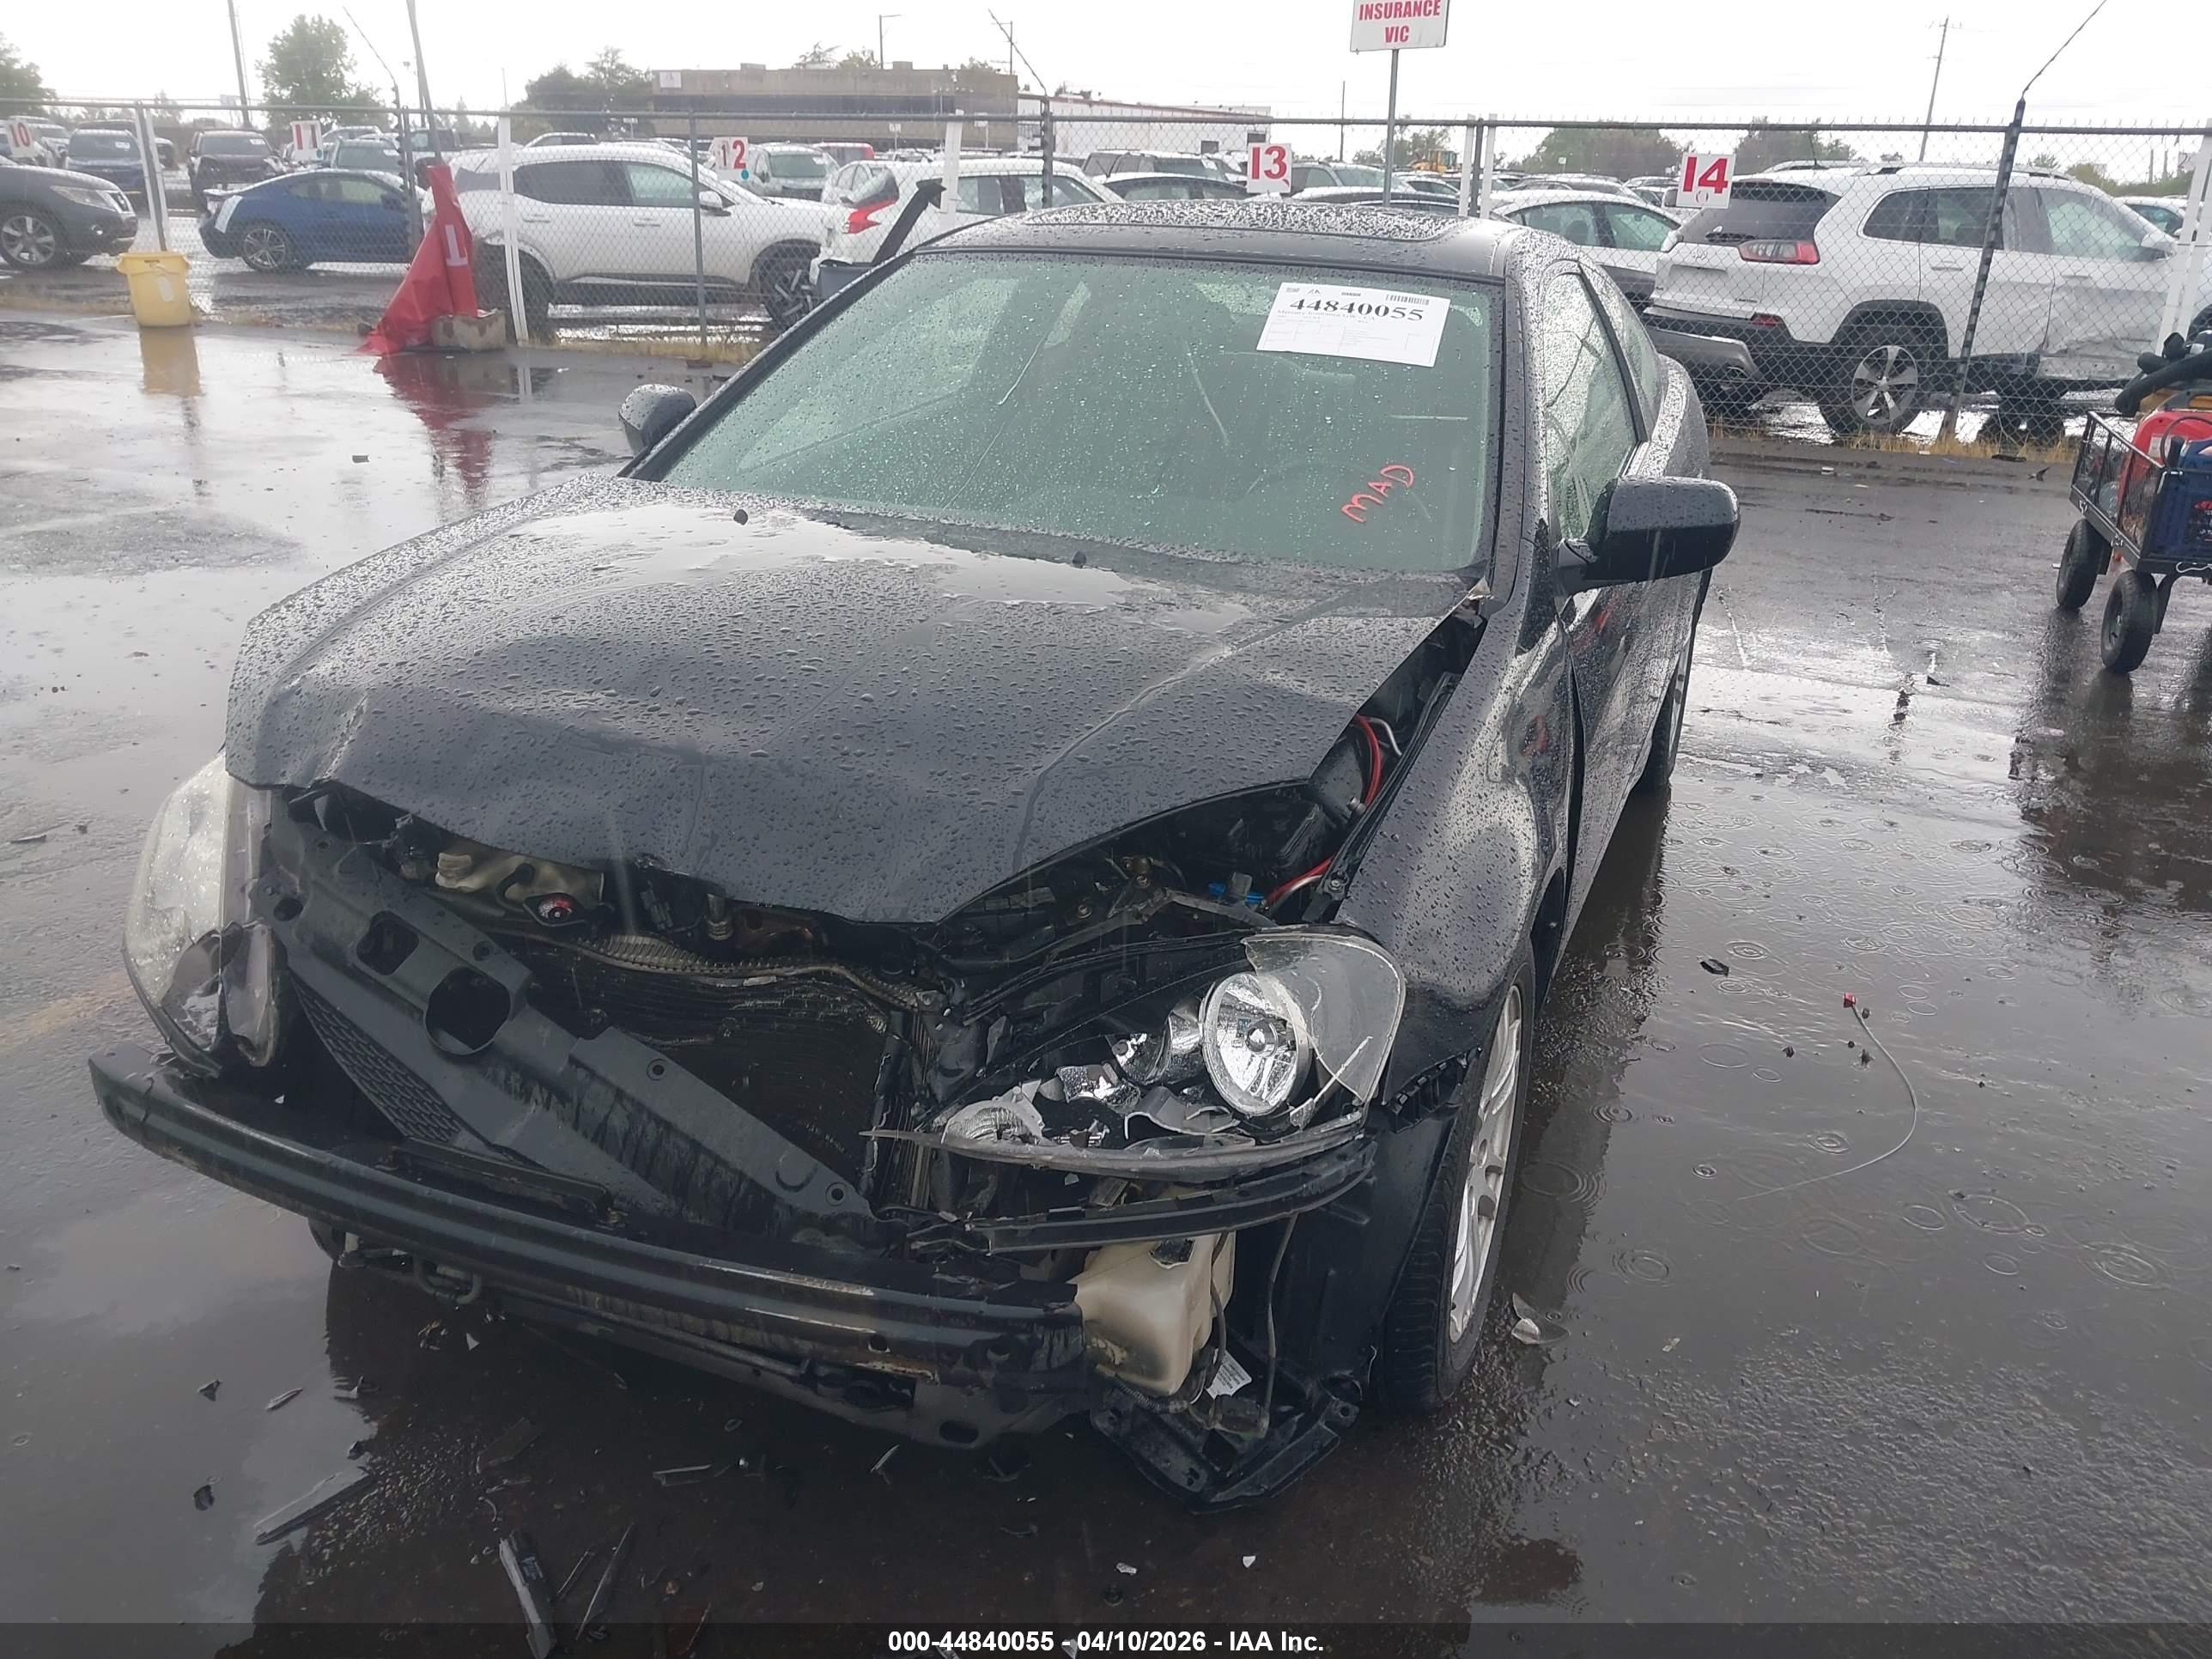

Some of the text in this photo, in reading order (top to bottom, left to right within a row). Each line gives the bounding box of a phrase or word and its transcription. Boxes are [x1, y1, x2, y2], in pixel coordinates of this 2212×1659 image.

[1358, 0, 1441, 21] INSURANCE
[1384, 26, 1409, 43] VIC
[9, 122, 31, 148] 10
[720, 139, 746, 170] 12
[1251, 145, 1287, 179] 13
[1682, 156, 1729, 194] 14
[1289, 298, 1425, 322] 44840055
